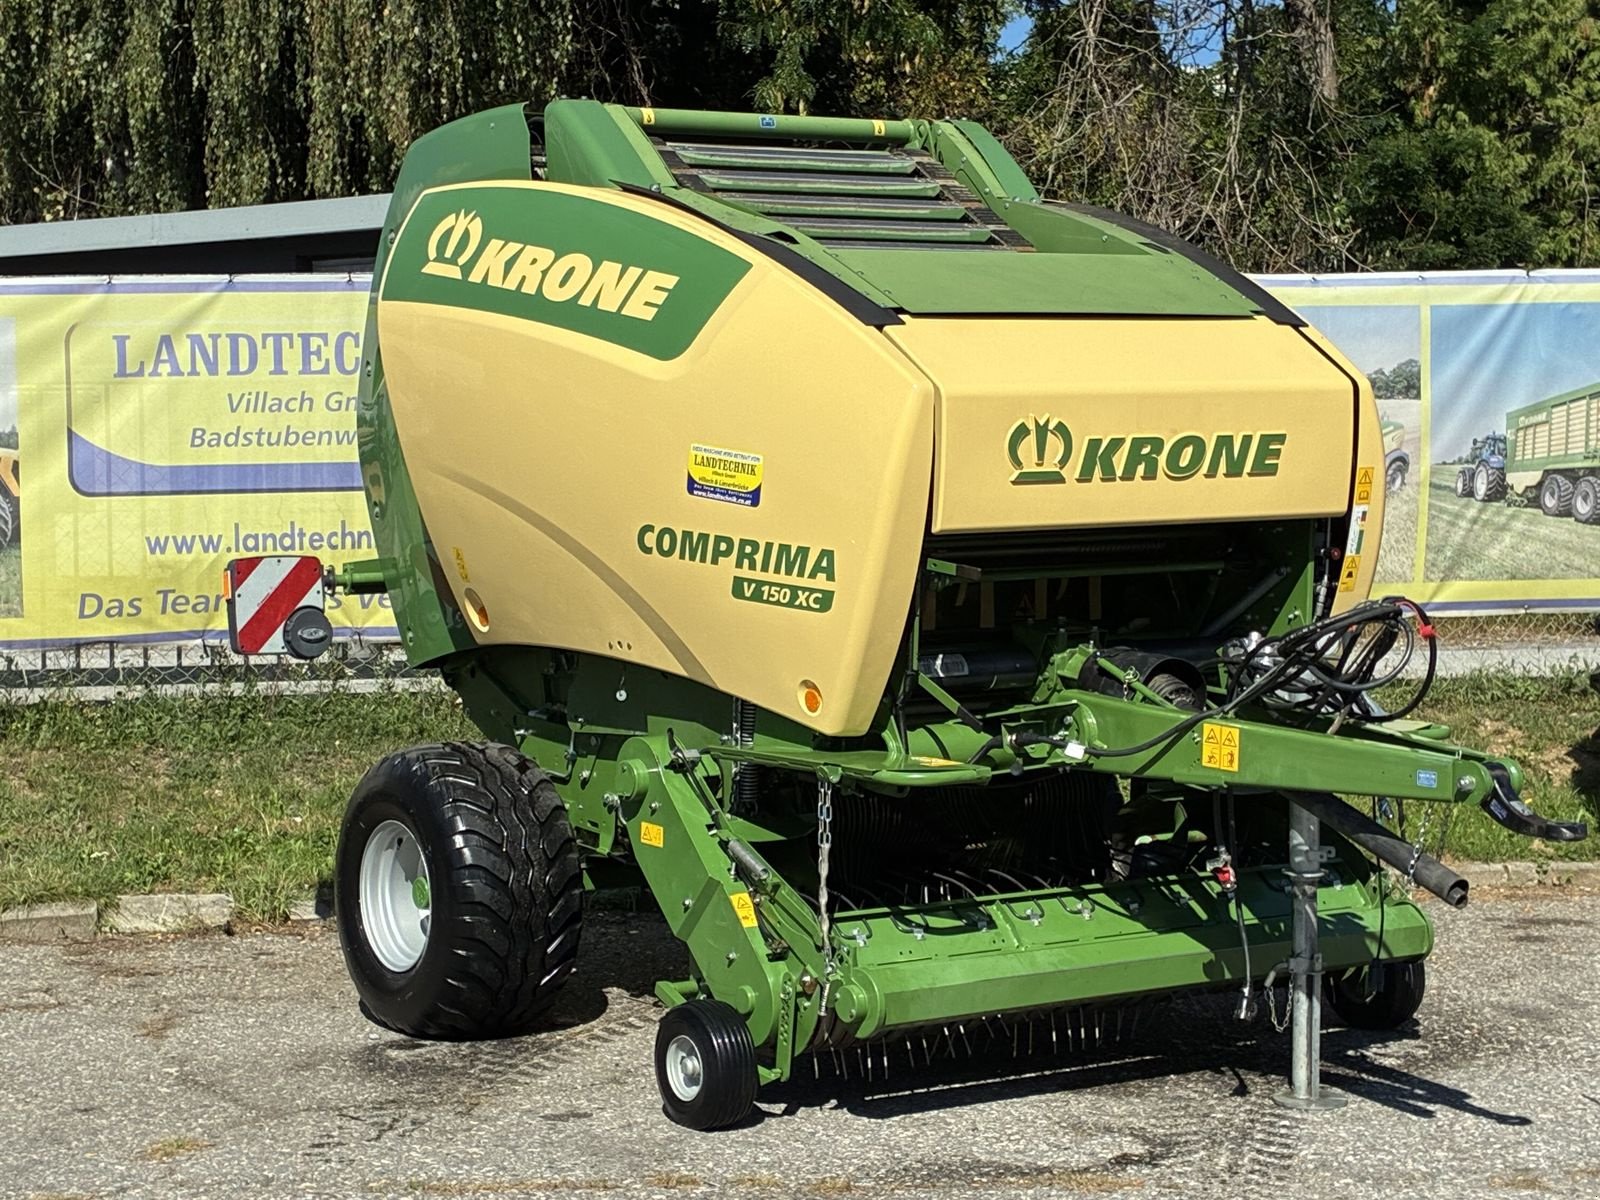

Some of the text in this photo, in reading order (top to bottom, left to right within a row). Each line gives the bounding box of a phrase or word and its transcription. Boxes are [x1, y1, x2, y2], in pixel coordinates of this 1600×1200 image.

[467, 238, 680, 321] KRONE
[112, 331, 361, 378] LANDTEC
[227, 391, 314, 413] Villach
[694, 454, 757, 476] LANDTECHNIK
[1074, 432, 1287, 483] KRONE
[637, 524, 836, 582] COMPRIMA
[78, 593, 142, 619] Das
[742, 582, 823, 609] V 150 XC
